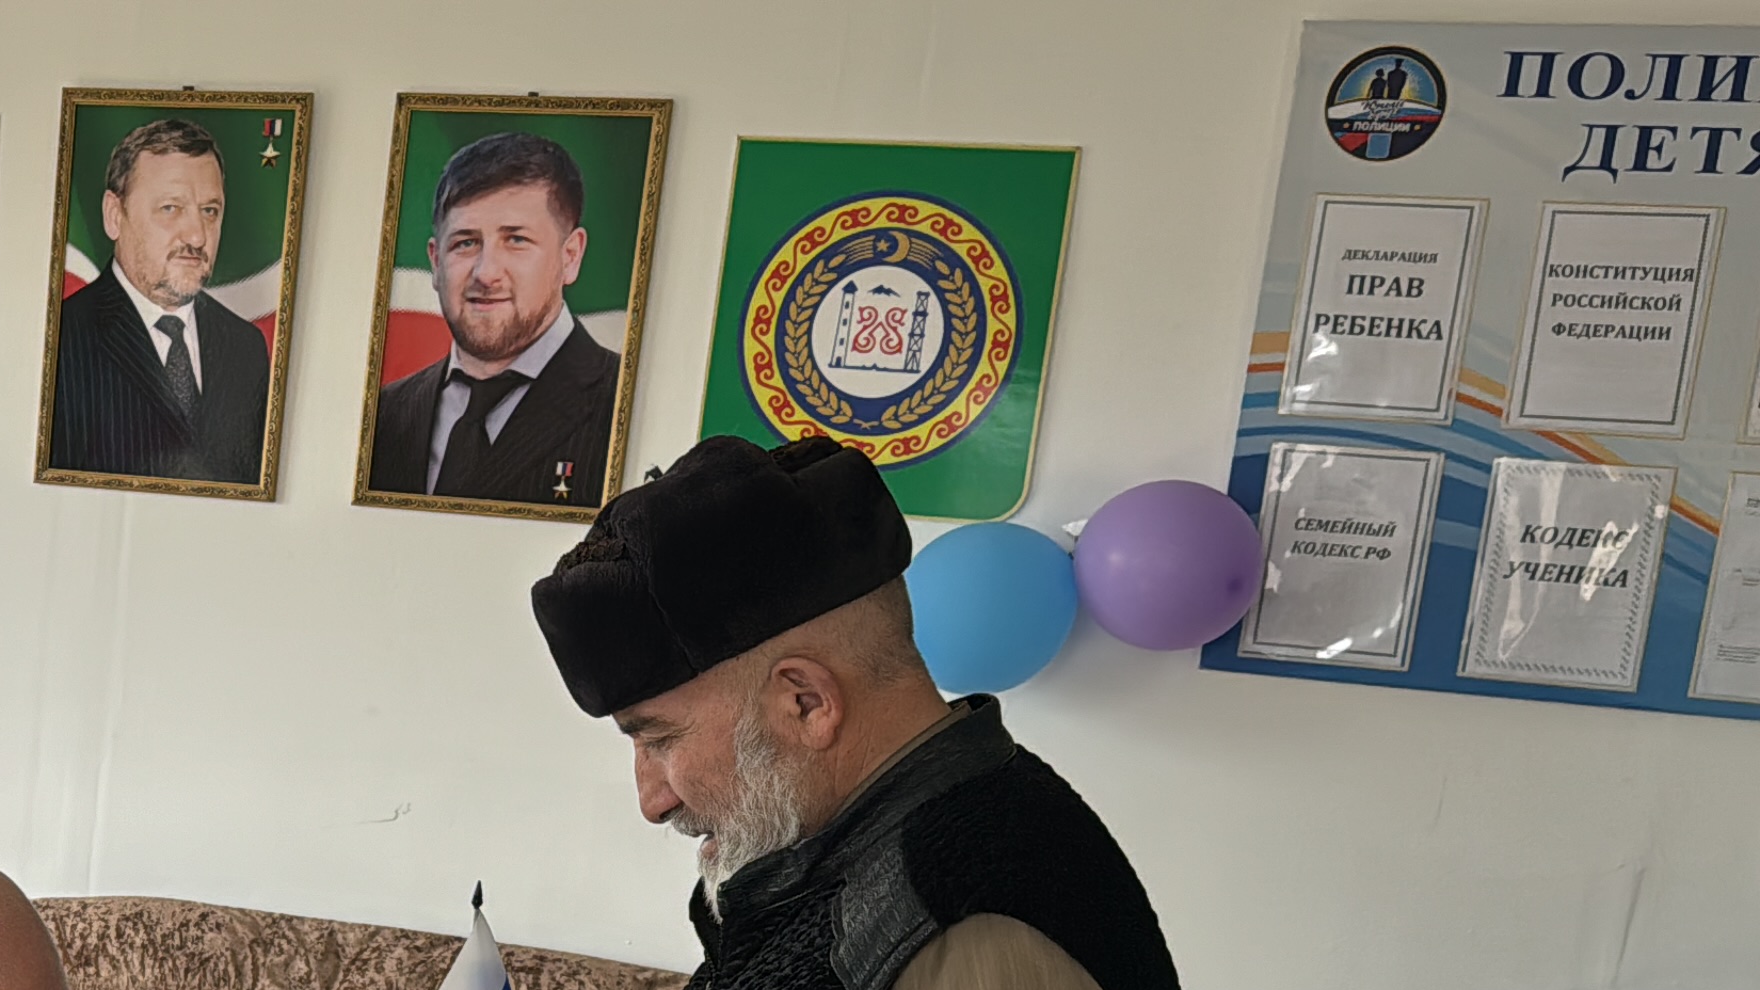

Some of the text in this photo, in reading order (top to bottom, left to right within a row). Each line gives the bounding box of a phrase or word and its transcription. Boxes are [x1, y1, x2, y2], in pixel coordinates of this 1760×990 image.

[1496, 50, 1760, 103] ПОЛИ
[1341, 248, 1439, 265] ДЕКЛАРАЦИЯ
[1547, 263, 1696, 284] КОНСТИТУЦИЯ
[1345, 274, 1425, 299] ПРАВ
[1550, 290, 1684, 313] РОССИЙСКОЙ
[1312, 313, 1444, 342] РЕБЕНКА
[1550, 321, 1673, 343] ФЕДЕРАЦИИ
[1294, 517, 1398, 538] СЕМЕЙНЫЙ
[1290, 540, 1392, 561] КОДЕКС РФ
[1502, 560, 1630, 588] УЧЕНИКА
